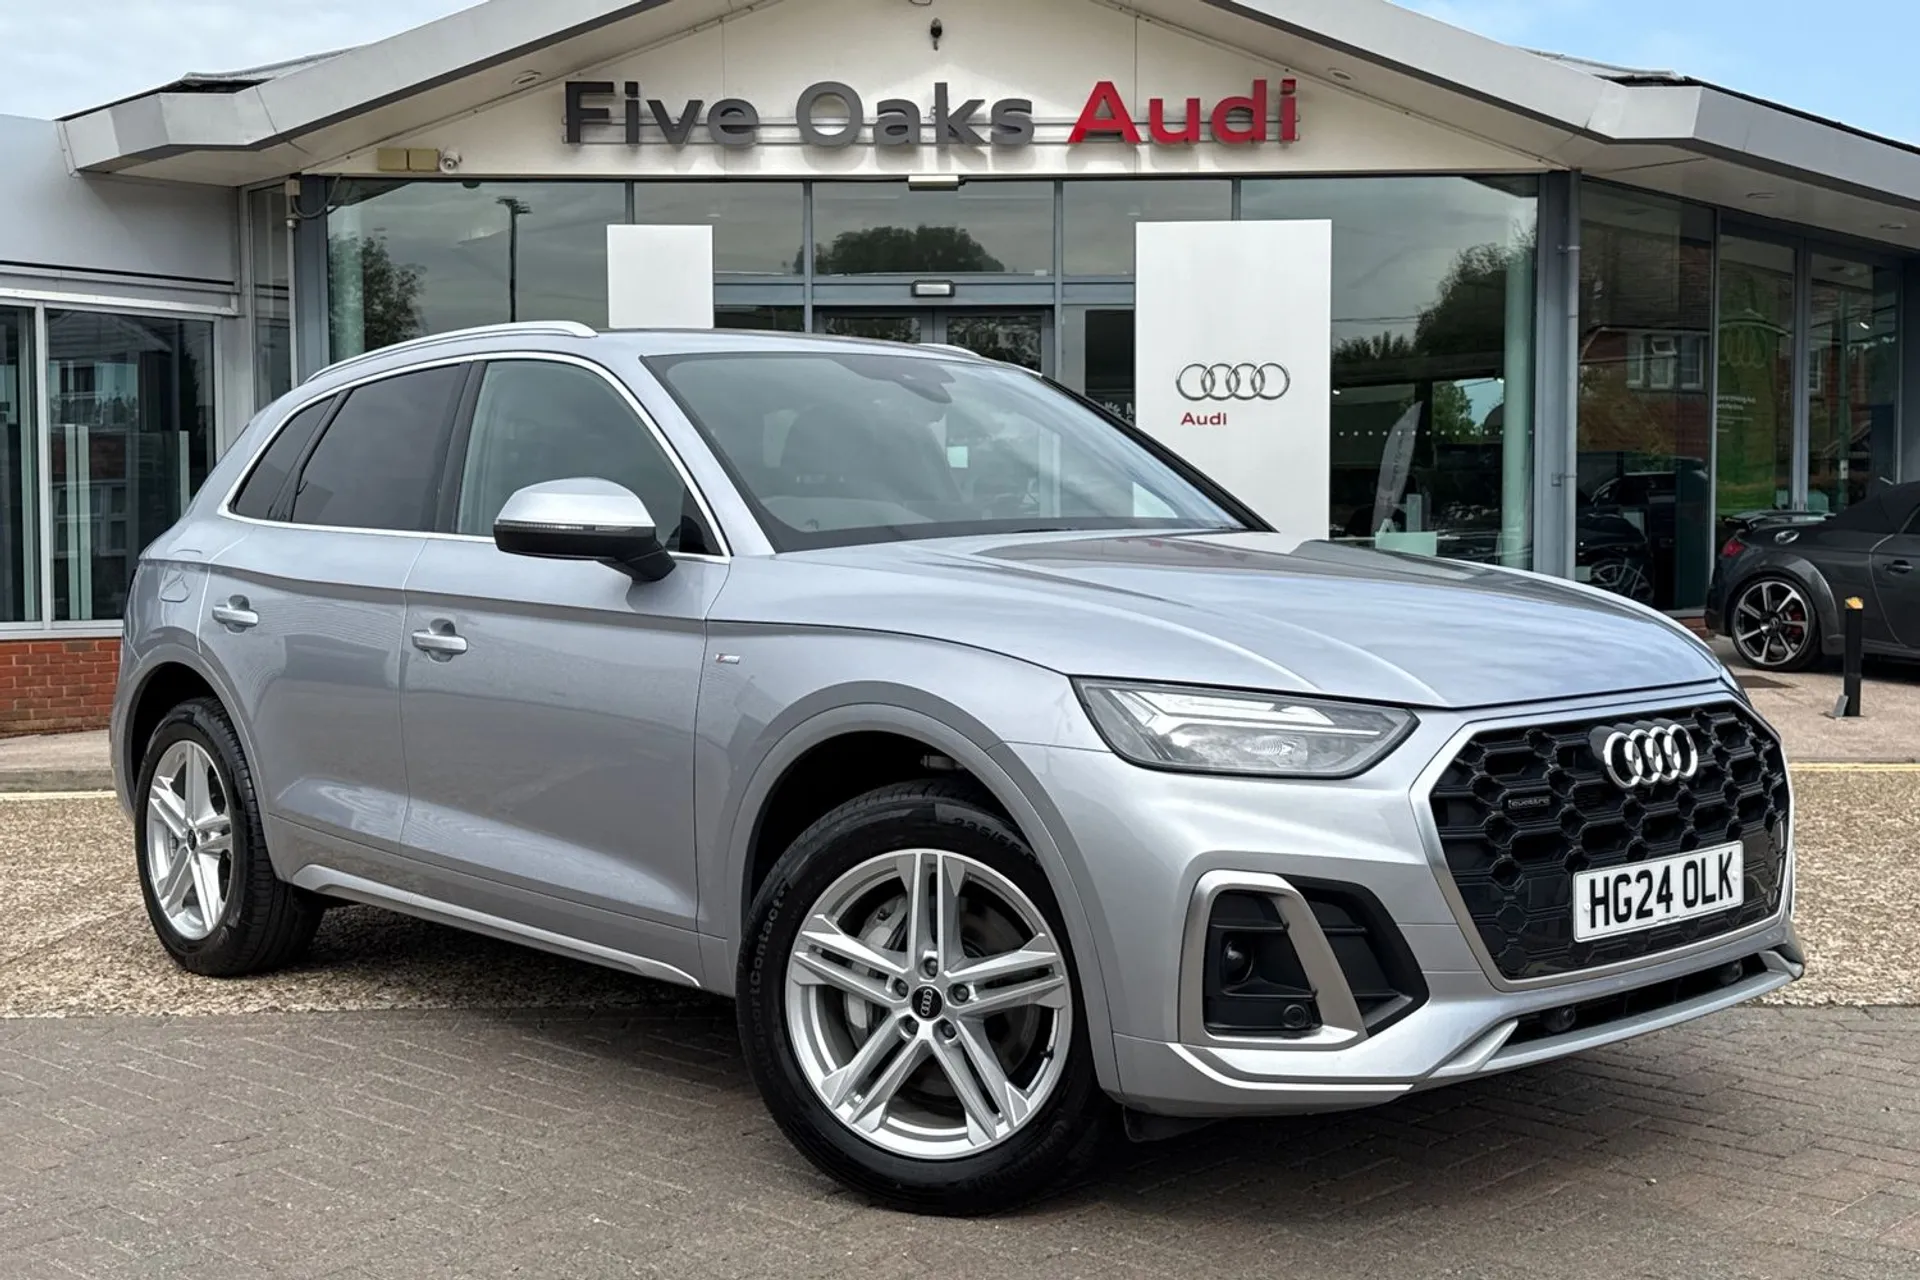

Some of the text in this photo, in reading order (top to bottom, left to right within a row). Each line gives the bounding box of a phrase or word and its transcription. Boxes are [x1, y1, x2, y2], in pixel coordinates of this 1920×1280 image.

[565, 79, 1297, 146] Five Oaks Audi
[1181, 412, 1227, 425] Audi
[1589, 851, 1733, 929] HG24 OLK
